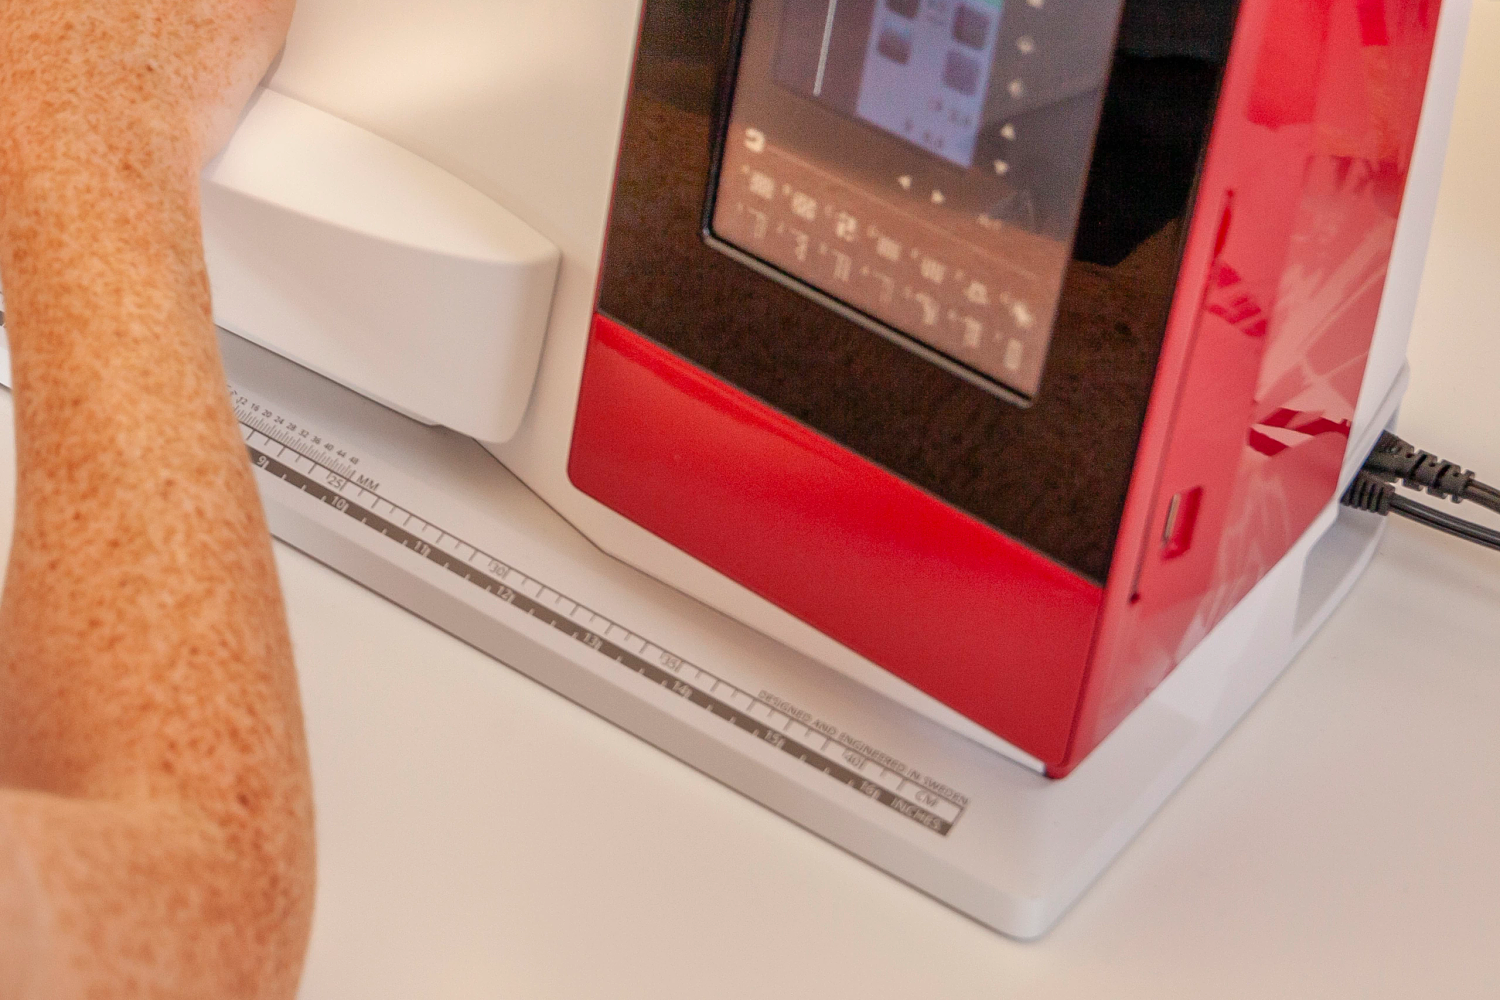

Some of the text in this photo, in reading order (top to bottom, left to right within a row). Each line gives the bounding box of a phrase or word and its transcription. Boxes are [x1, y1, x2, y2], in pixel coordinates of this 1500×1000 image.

[251, 403, 260, 412] 16
[261, 409, 273, 418] 20
[274, 415, 285, 425] 24
[298, 429, 310, 439] 32
[323, 442, 335, 451] 40
[336, 449, 347, 458] 44
[357, 473, 380, 492] MM
[257, 455, 267, 467] 9
[331, 496, 346, 510] 10
[497, 585, 513, 600] 12
[583, 632, 599, 648] 13
[672, 680, 688, 696] 14
[765, 730, 780, 744] 15
[890, 797, 943, 829] INCHES
[328, 475, 343, 489] 25
[489, 562, 505, 577] 30
[844, 751, 861, 767] 40
[915, 790, 938, 807] CM
[757, 689, 969, 805] DESIGNED AND ENGINEERED IN SWEDEN
